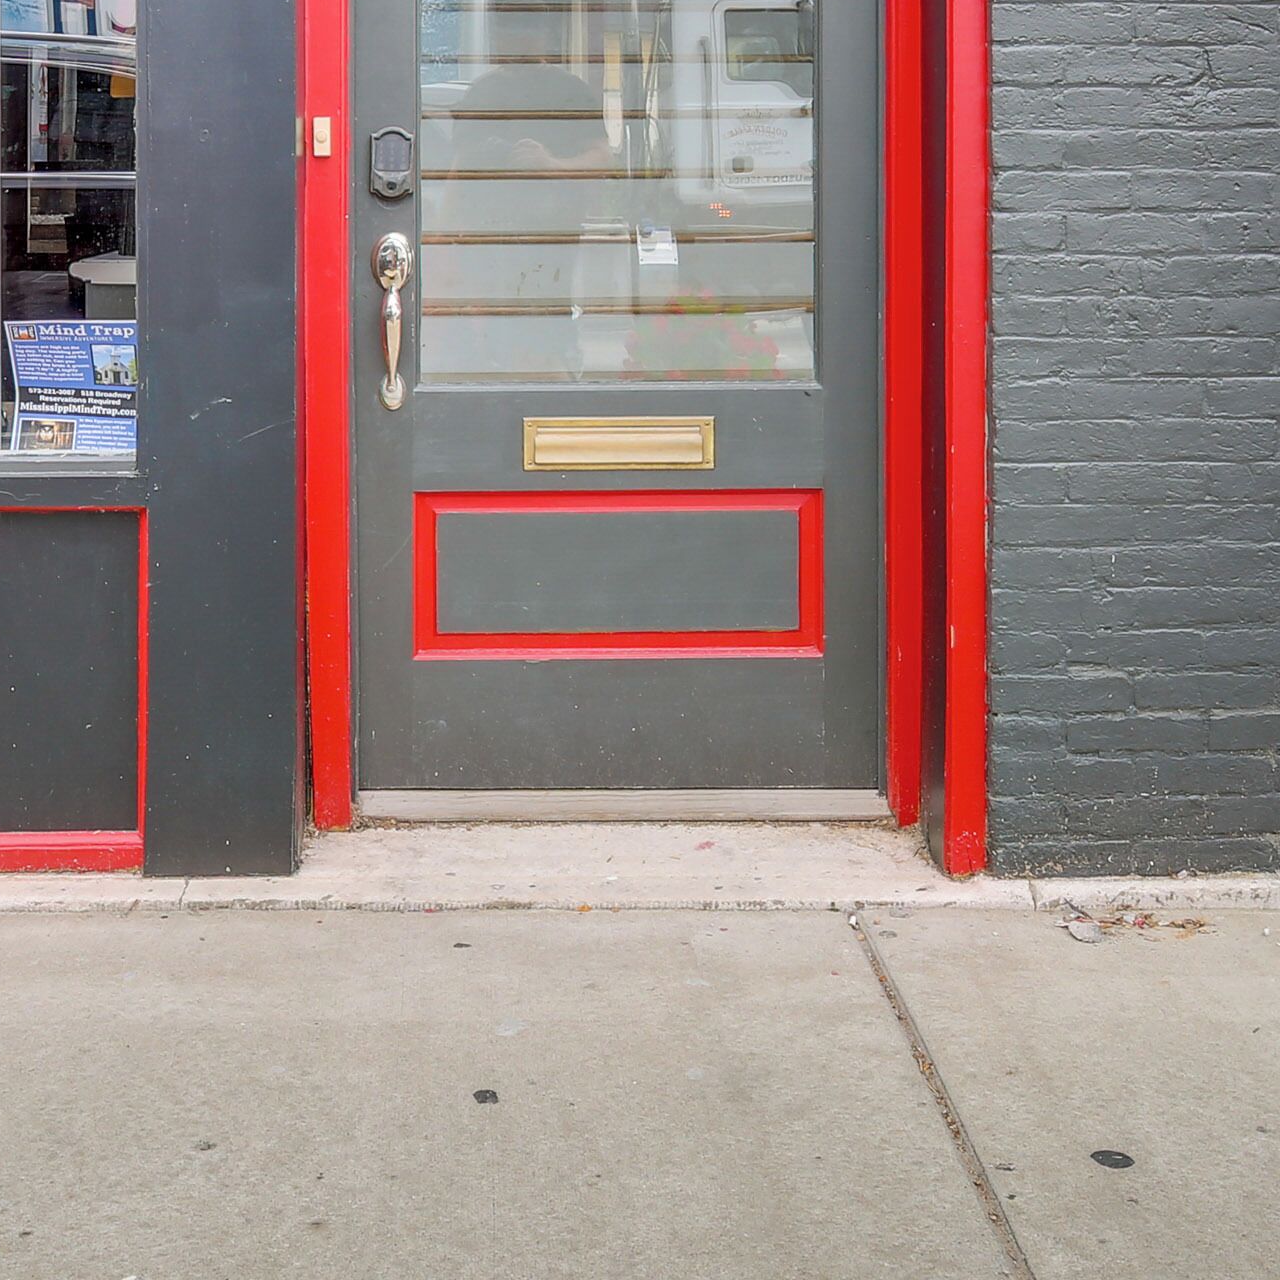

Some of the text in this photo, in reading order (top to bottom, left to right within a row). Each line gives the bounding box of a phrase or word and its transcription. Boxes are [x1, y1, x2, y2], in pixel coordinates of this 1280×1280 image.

[39, 324, 134, 338] Mind Trap
[39, 395, 121, 406] Reservations Required
[95, 391, 132, 400] Broadway
